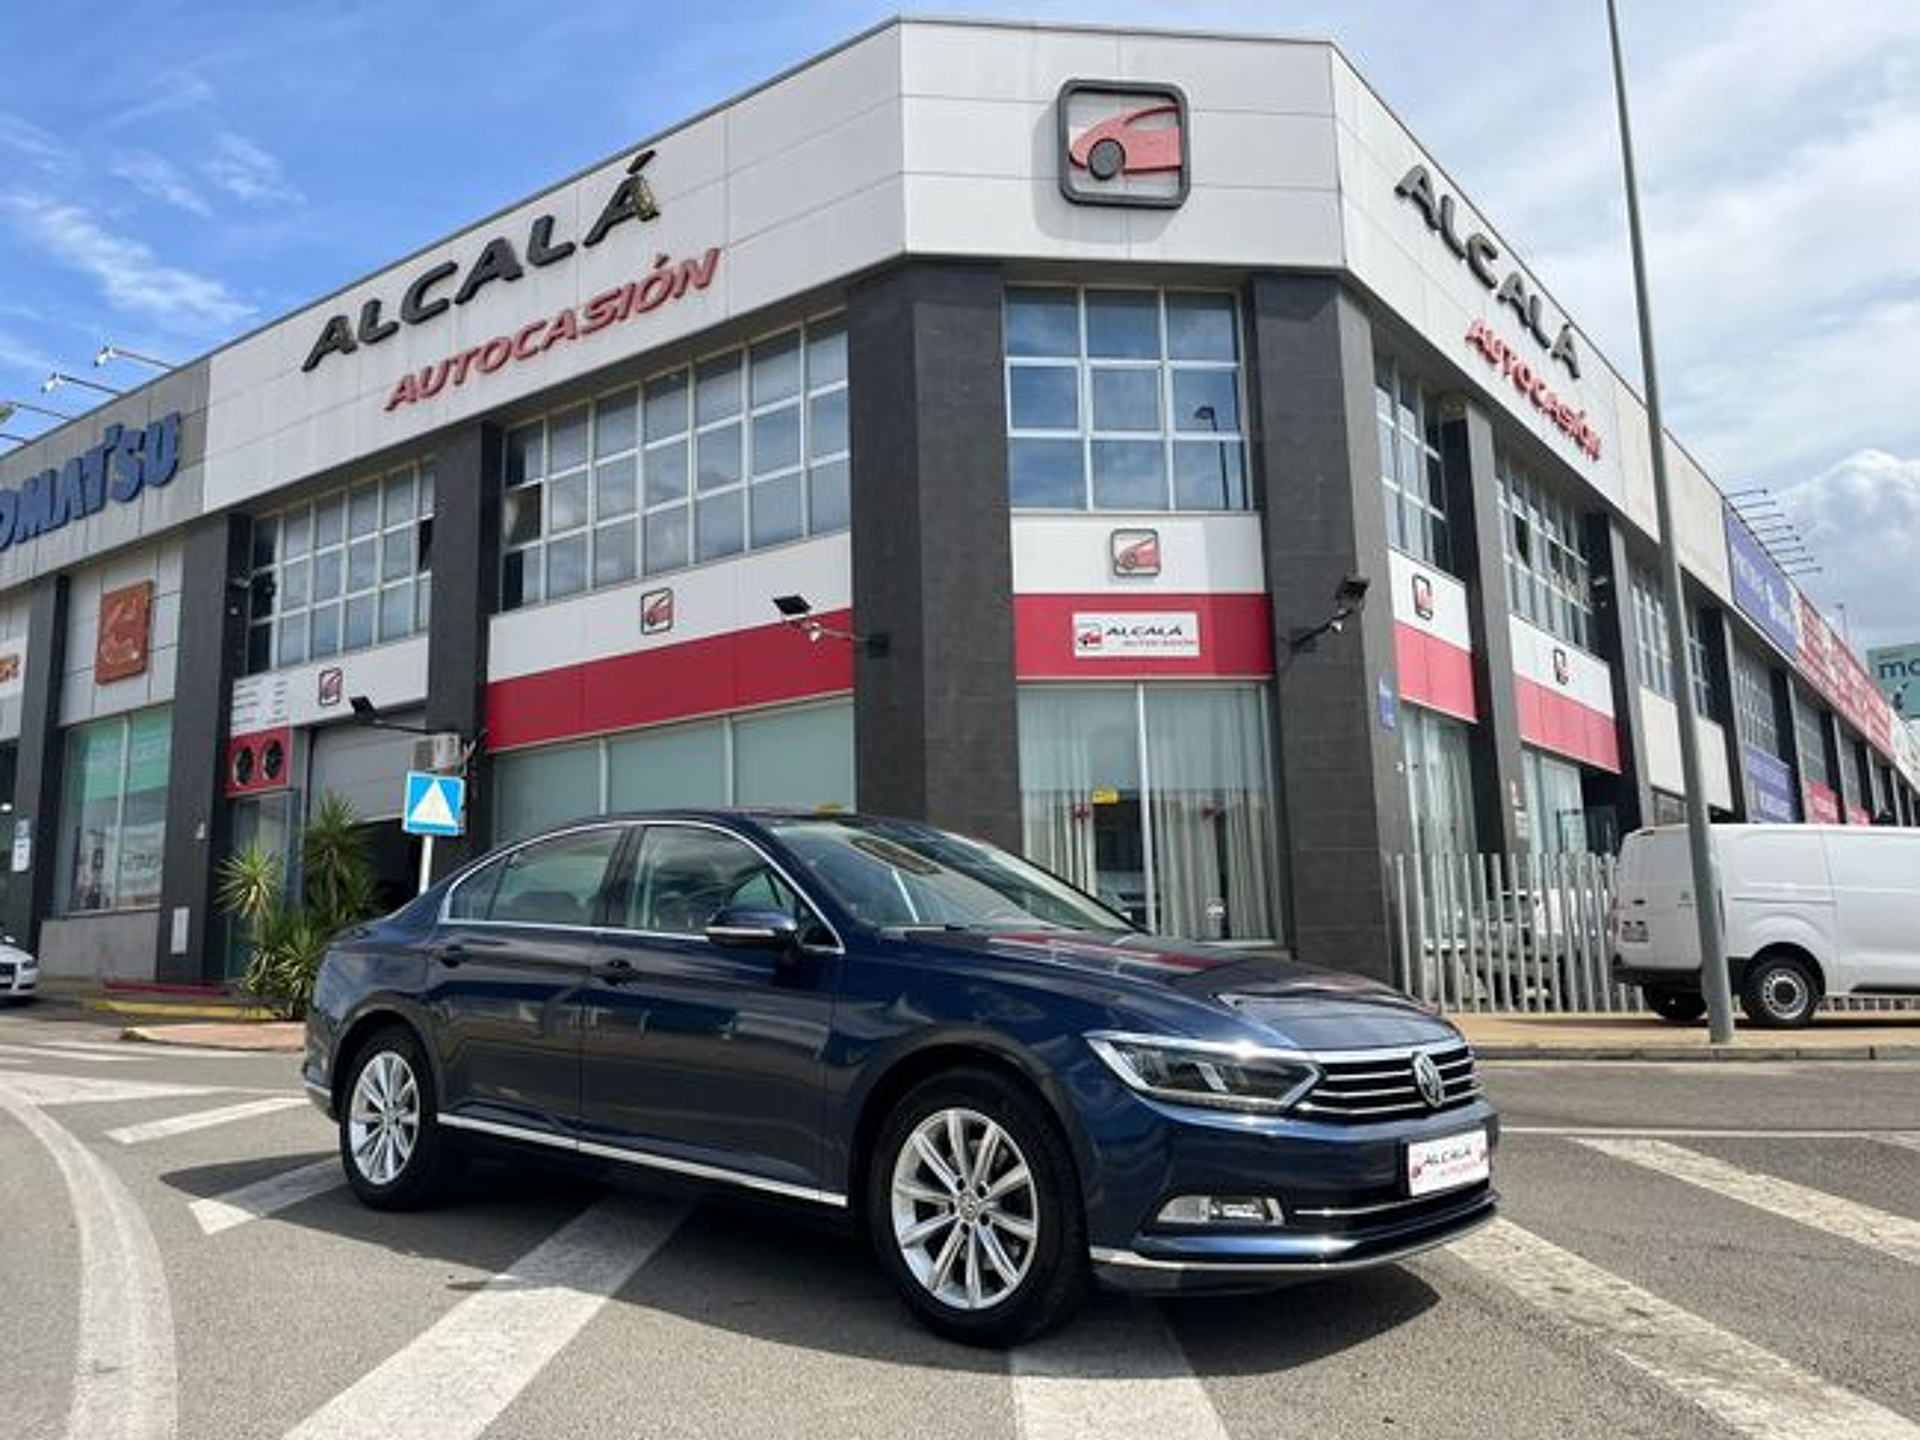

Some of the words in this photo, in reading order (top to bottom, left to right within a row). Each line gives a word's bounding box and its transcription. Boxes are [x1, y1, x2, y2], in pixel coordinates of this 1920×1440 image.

[301, 150, 661, 373] ALCALÁ
[384, 247, 721, 411] AUTOCASIÓN
[1394, 164, 1581, 380] ALCALÁ
